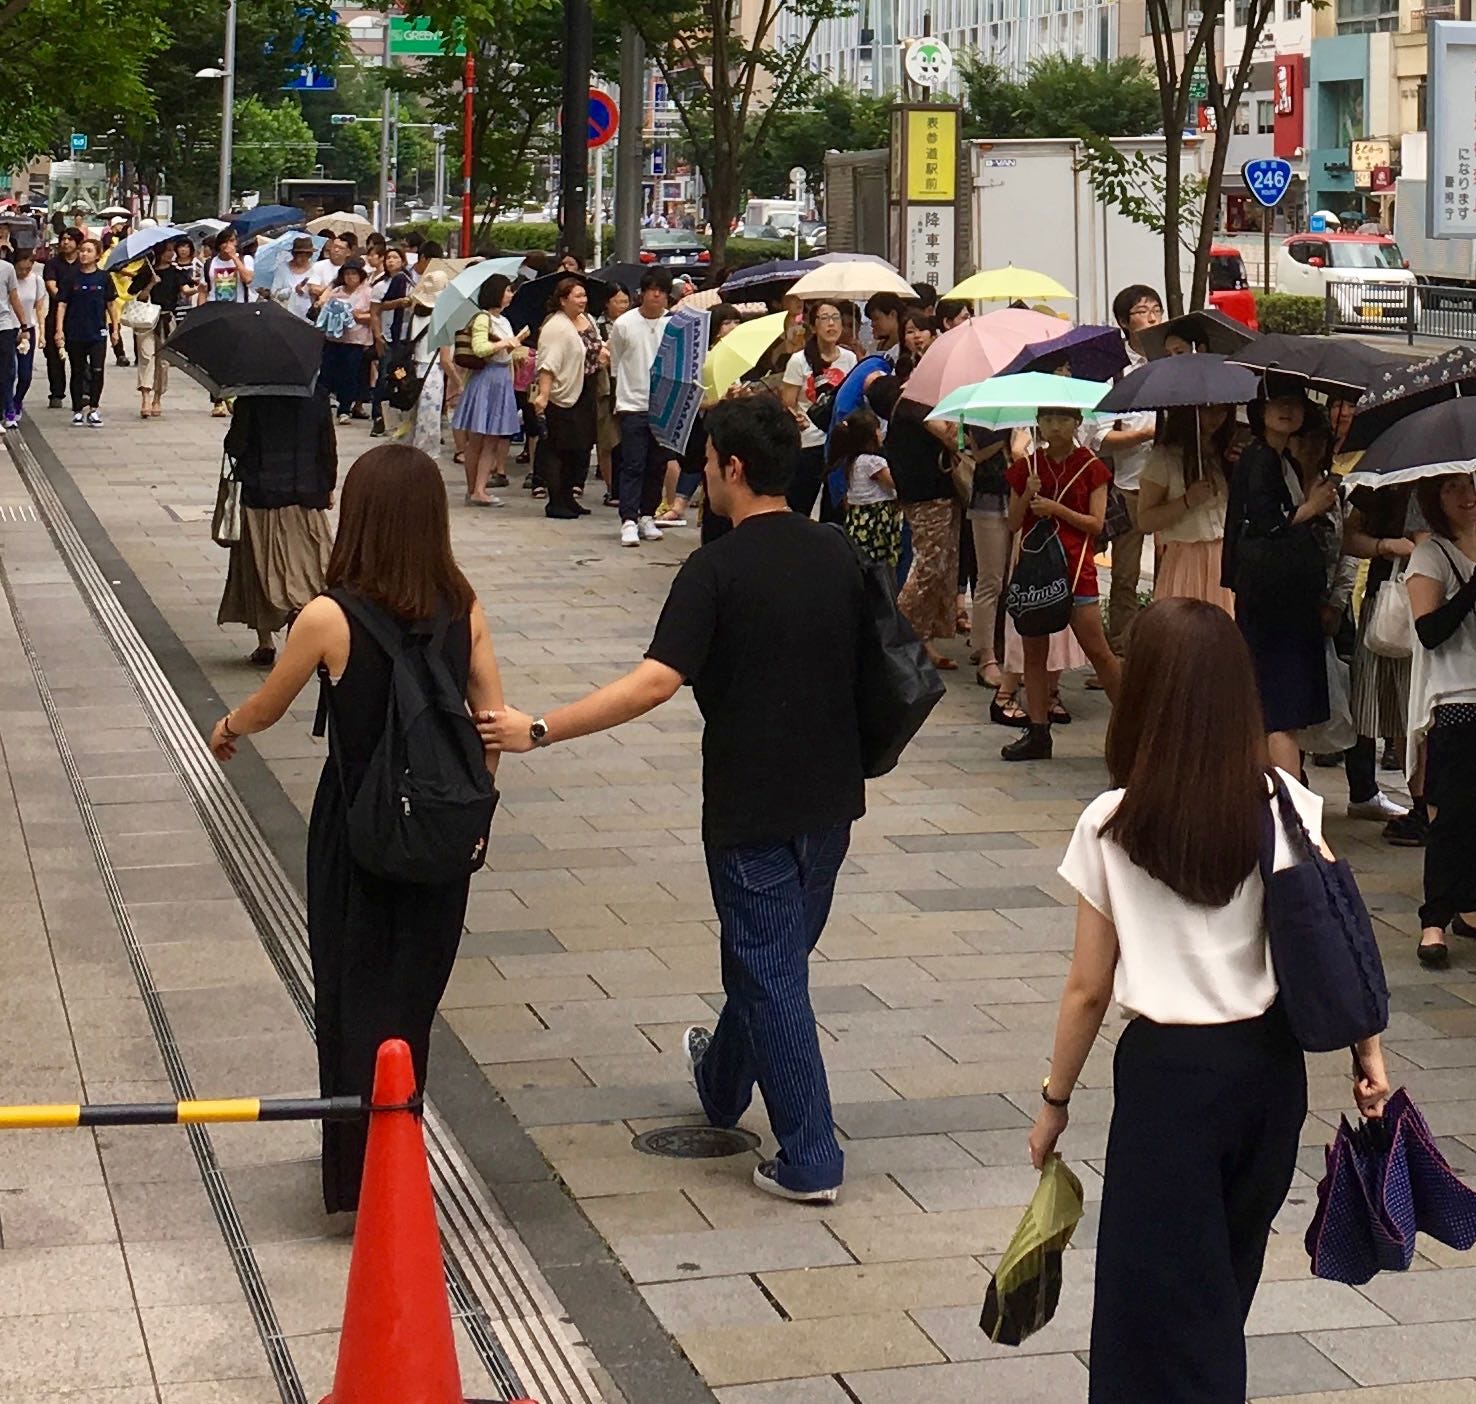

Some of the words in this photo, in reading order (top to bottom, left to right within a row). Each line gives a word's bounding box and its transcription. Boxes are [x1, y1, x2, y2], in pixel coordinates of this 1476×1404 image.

[926, 117, 939, 190] 表参道駅前
[1253, 170, 1285, 188] 246
[1458, 148, 1470, 221] になります
[924, 211, 940, 287] 降車専用
